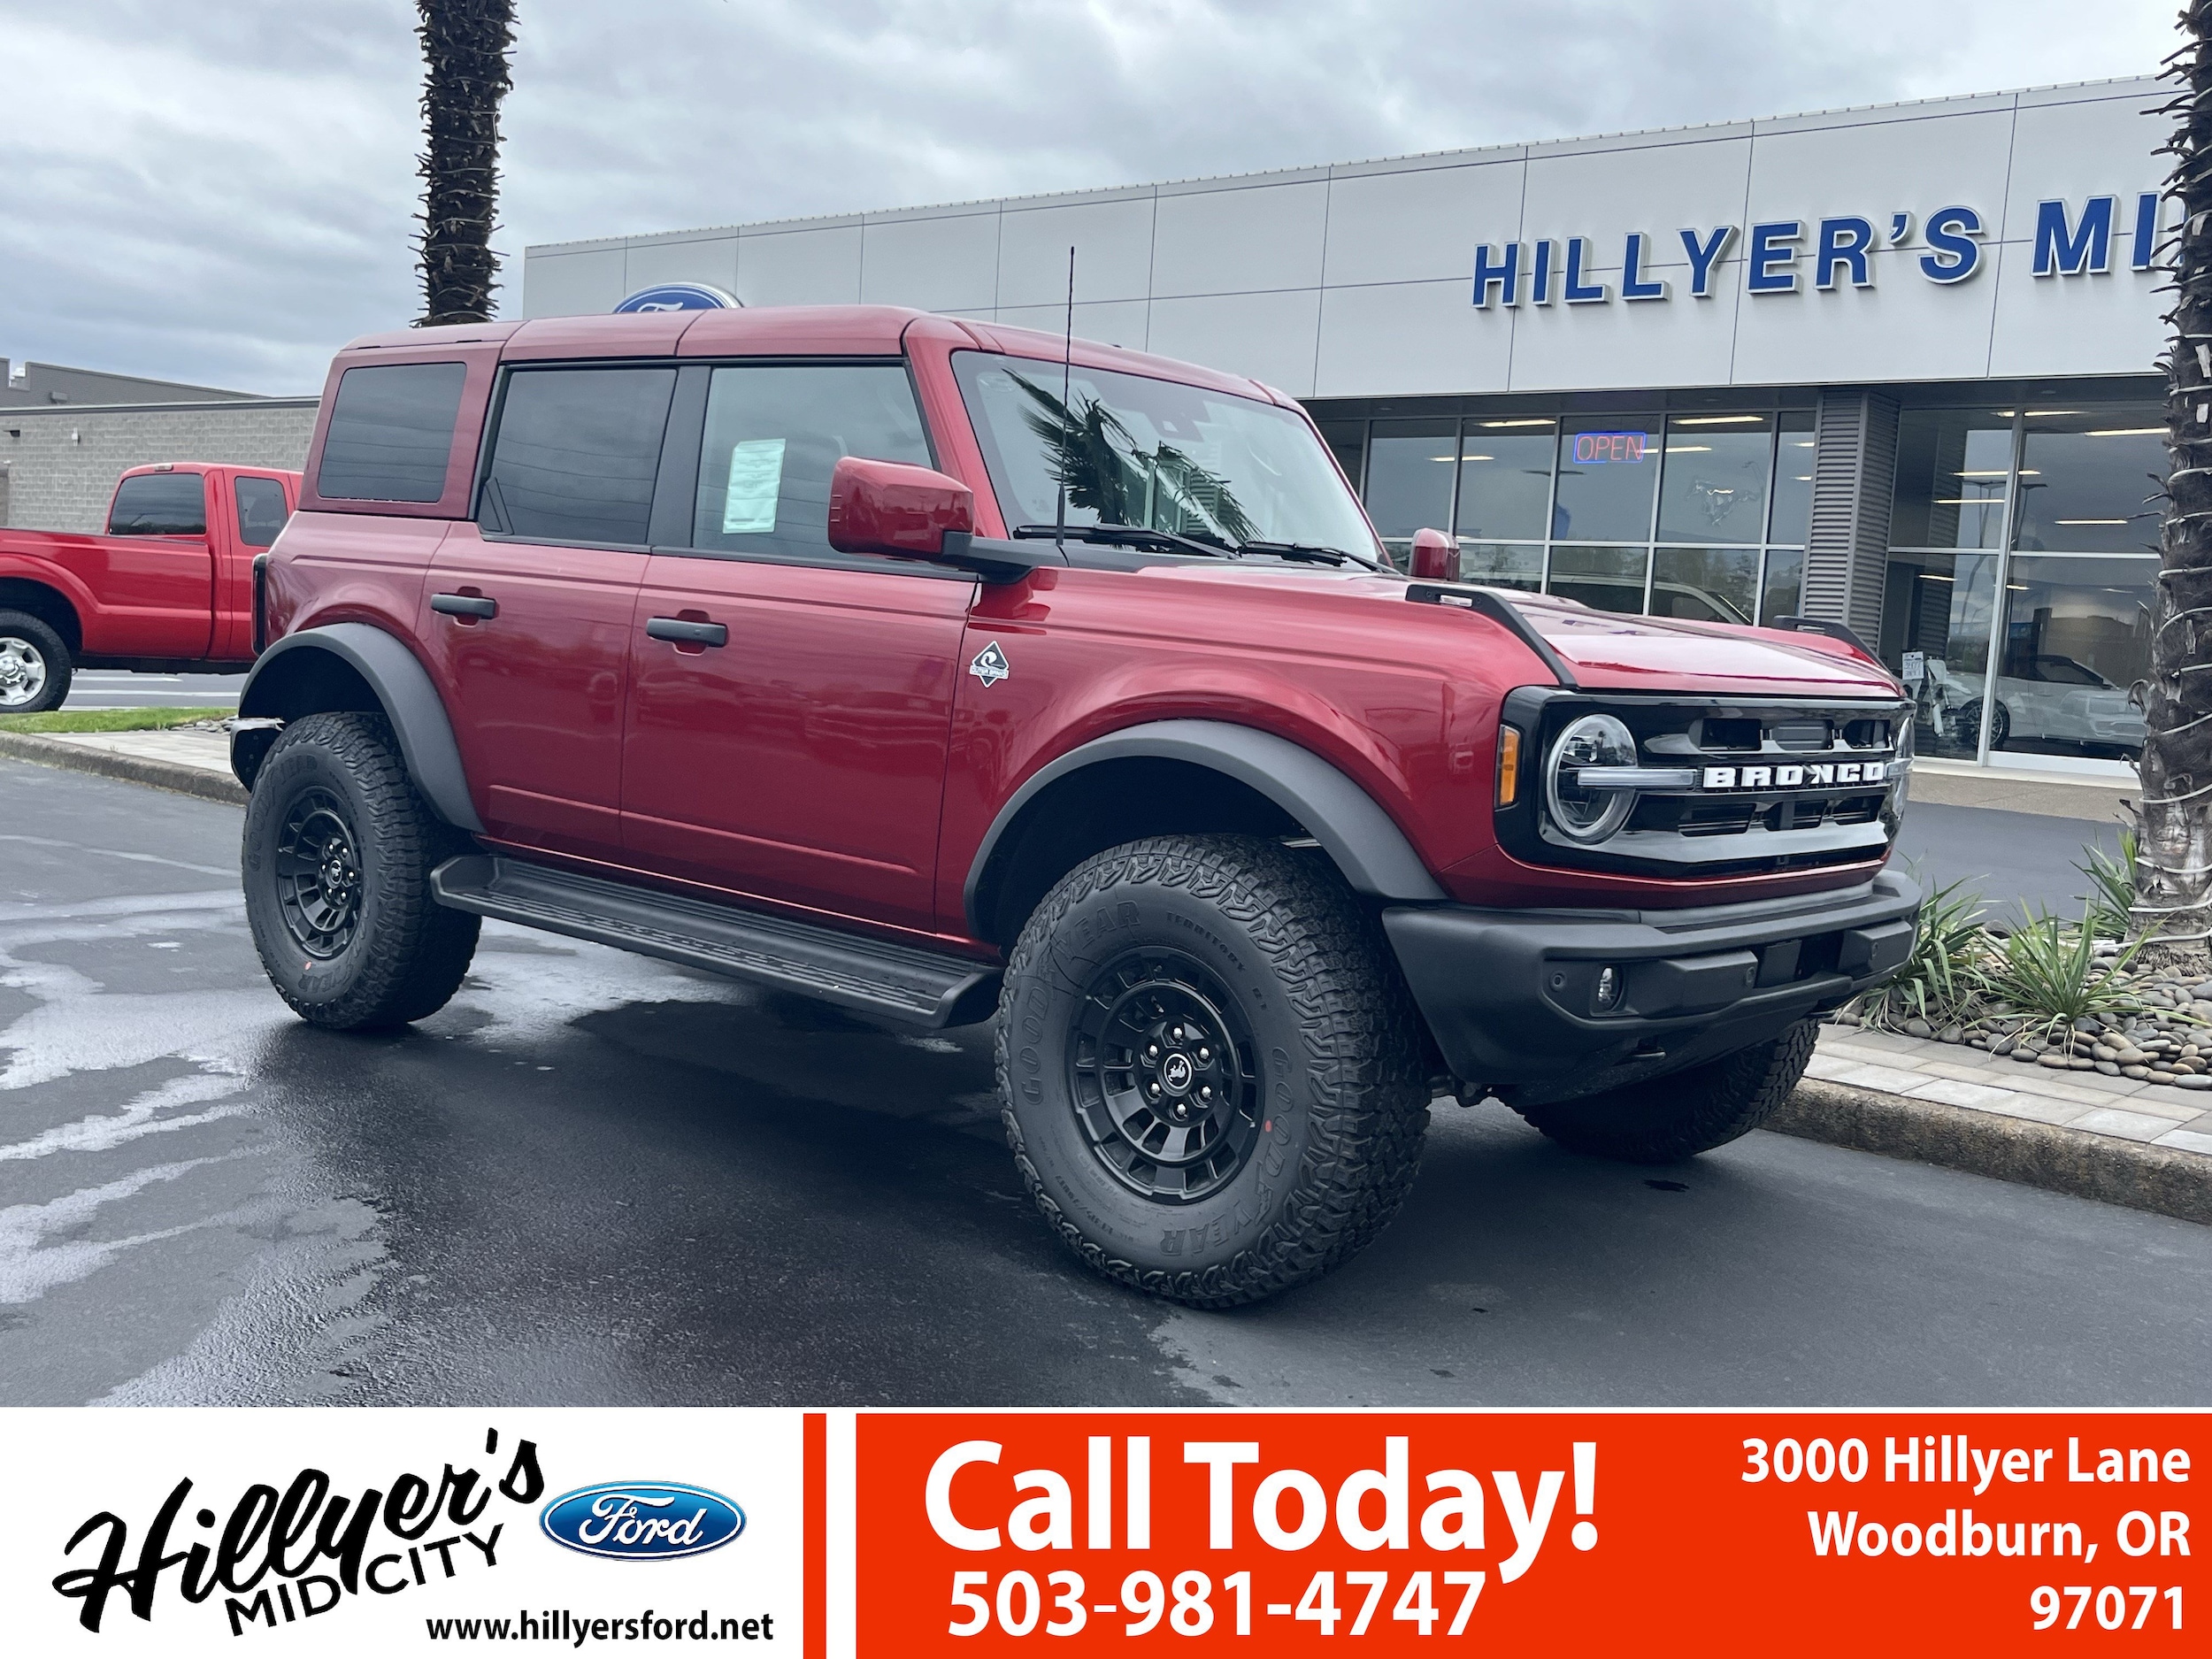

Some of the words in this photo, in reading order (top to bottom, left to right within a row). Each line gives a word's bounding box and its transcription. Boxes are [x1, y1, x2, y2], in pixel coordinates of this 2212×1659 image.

[1471, 205, 1982, 307] HILLYER'S
[2031, 191, 2189, 275] MI
[1577, 435, 1643, 460] OPEN
[1702, 762, 1885, 788] BRONCO
[1165, 911, 1247, 973] TERRITORY
